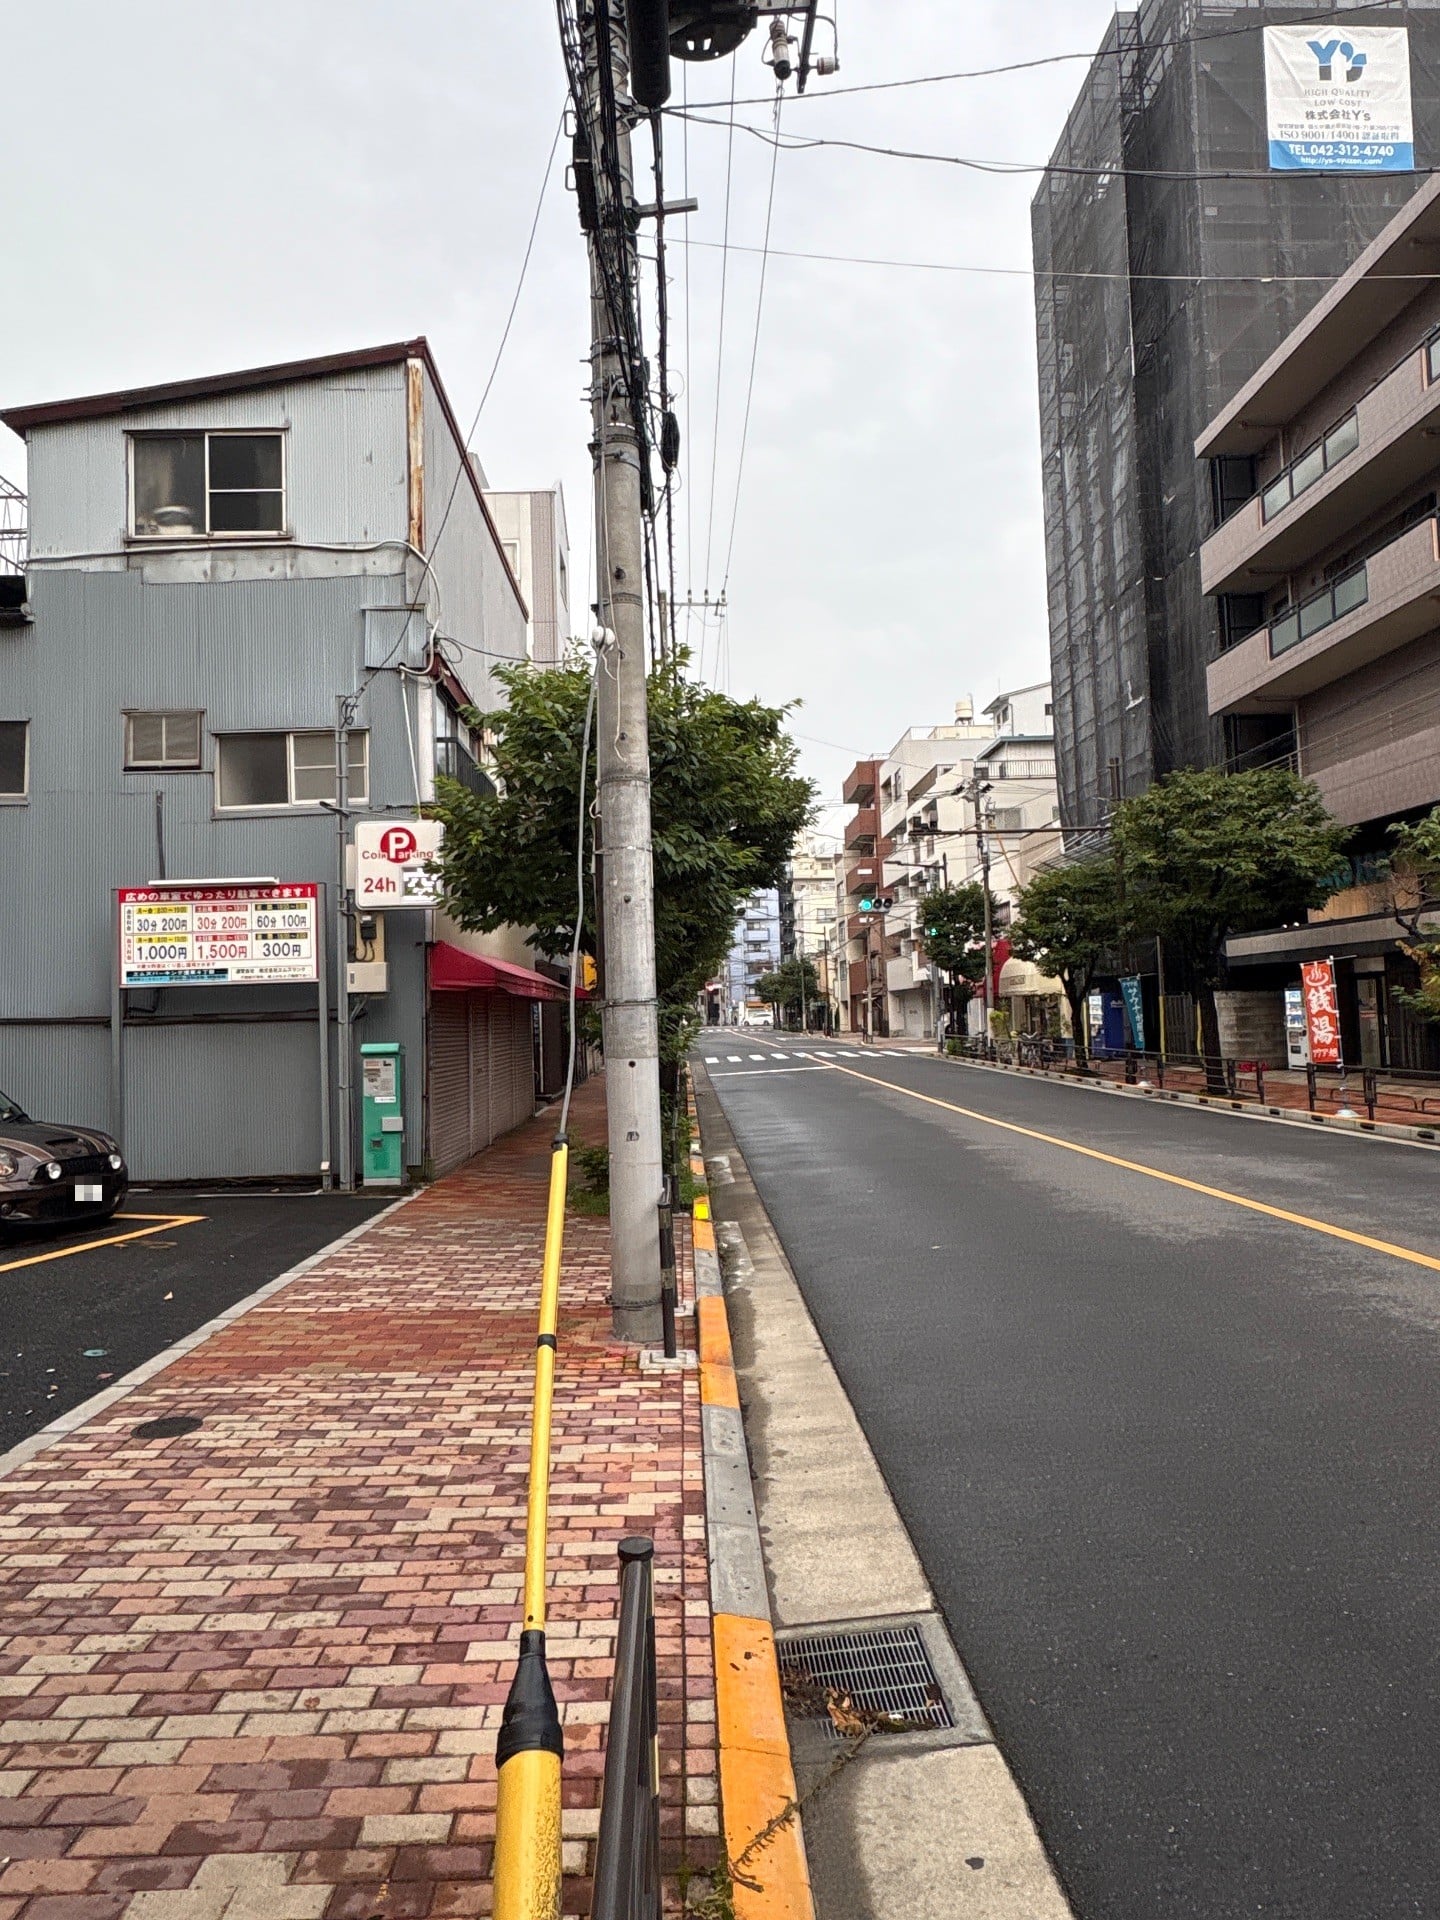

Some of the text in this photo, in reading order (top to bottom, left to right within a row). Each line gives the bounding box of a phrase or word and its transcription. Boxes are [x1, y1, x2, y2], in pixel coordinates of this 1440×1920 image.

[1304, 87, 1371, 97] HIGH QUALITY
[1314, 99, 1361, 107] LOW COST
[1280, 130, 1299, 140] ISO
[363, 877, 396, 893] 24h
[137, 918, 187, 931] 30分 200円
[197, 916, 247, 930] 30分 200円
[257, 914, 307, 928] 60分 100円
[262, 942, 301, 957] 300円
[1308, 985, 1337, 1045] 銭湯
